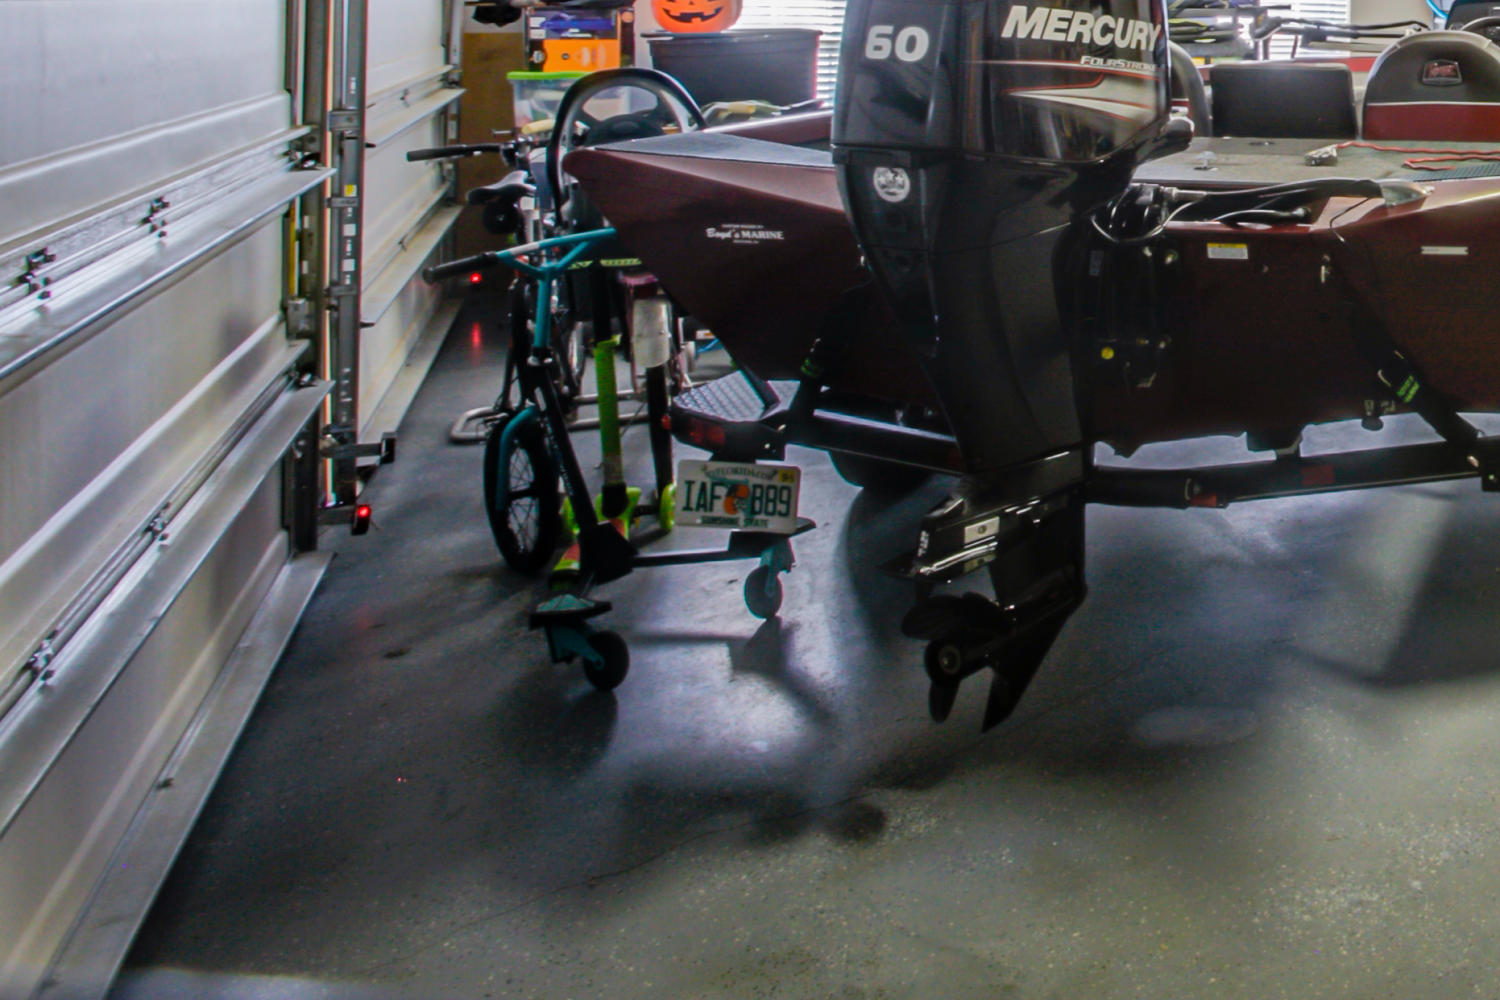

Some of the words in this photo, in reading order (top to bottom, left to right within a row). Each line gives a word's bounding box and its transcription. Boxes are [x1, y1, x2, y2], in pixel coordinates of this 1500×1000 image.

[865, 25, 930, 62] 60
[1001, 5, 1162, 52] MERCURY
[741, 230, 784, 240] MARINE
